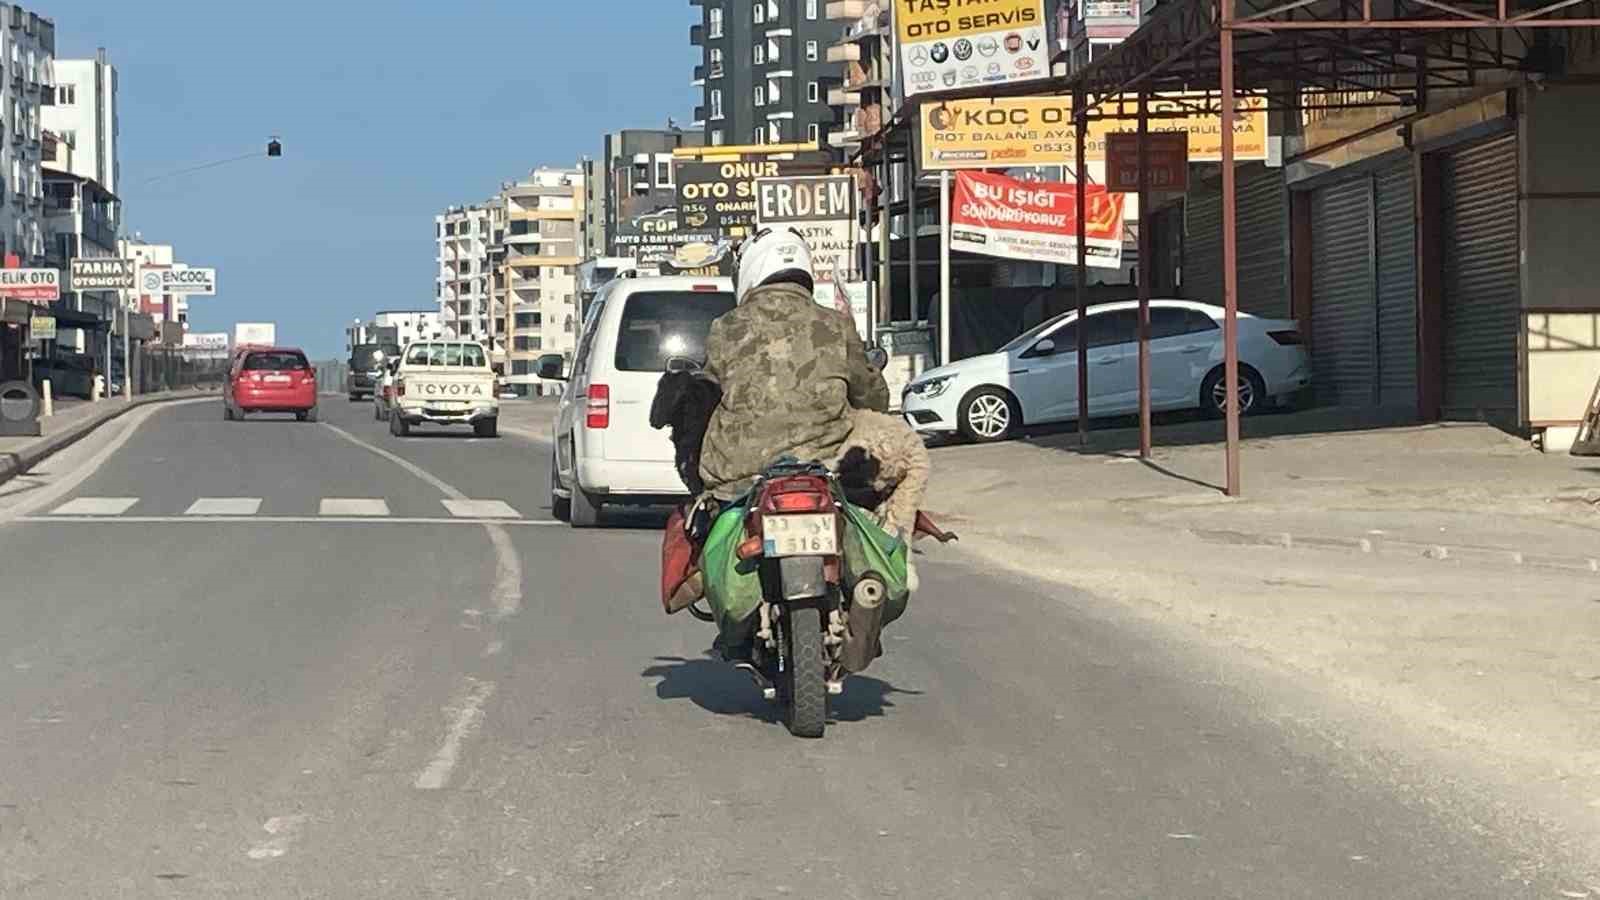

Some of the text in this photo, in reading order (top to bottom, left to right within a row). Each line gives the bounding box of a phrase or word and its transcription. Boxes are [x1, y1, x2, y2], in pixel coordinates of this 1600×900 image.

[907, 7, 1036, 37] OTO SERVİS
[965, 108, 1029, 129] KOÇ
[934, 133, 963, 142] ROT
[972, 130, 1037, 141] BALANS
[1044, 129, 1092, 139] AYA
[720, 162, 778, 178] ONUR
[682, 181, 756, 199] OTO S
[974, 181, 1003, 201] BU
[715, 201, 757, 212] ONARI
[761, 182, 850, 218] ERDEM
[73, 261, 134, 274] TARHAN
[31, 271, 55, 284] OTO
[162, 270, 212, 283] ENCOOL
[415, 383, 483, 395] TOYOTA
